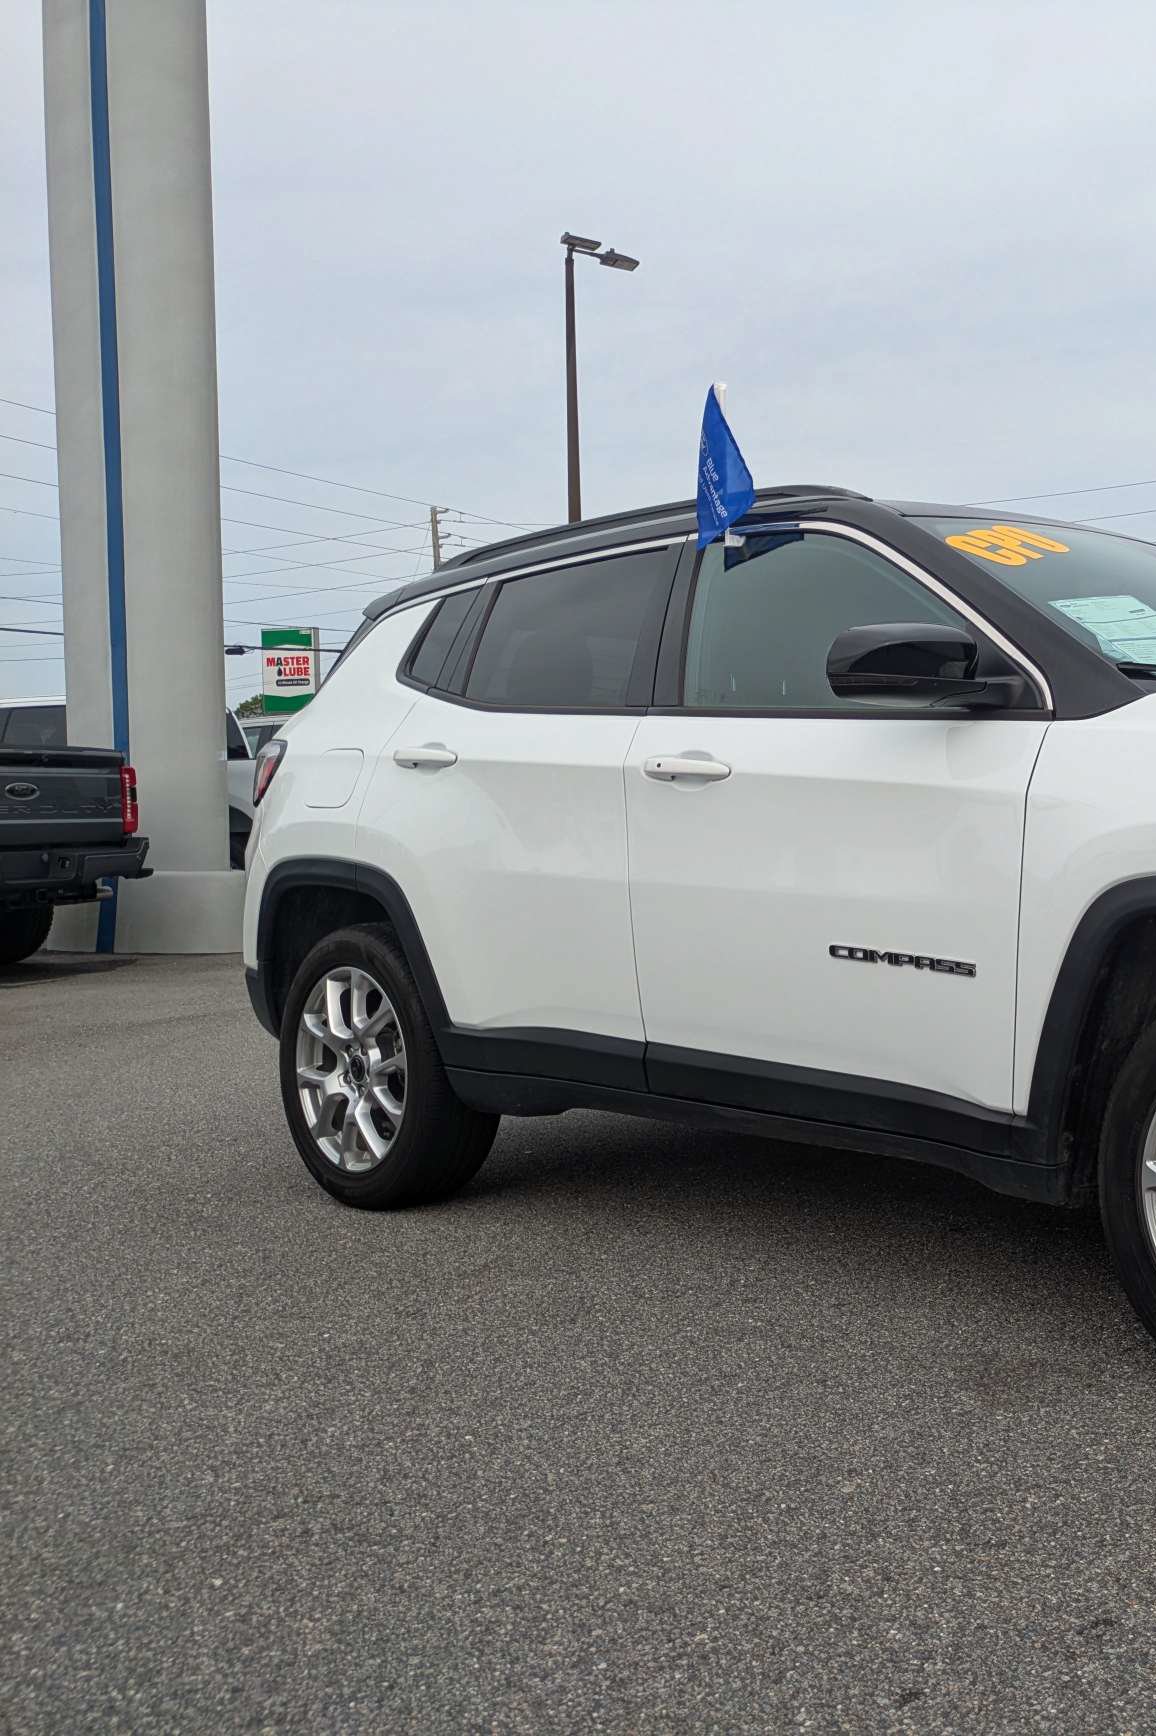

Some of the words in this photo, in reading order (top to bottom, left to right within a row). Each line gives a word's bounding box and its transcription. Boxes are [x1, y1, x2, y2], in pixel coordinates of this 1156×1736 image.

[945, 525, 1071, 566] CPO
[266, 656, 310, 667] MASTER
[283, 667, 310, 677] LUBE
[828, 944, 977, 978] COMPASS
